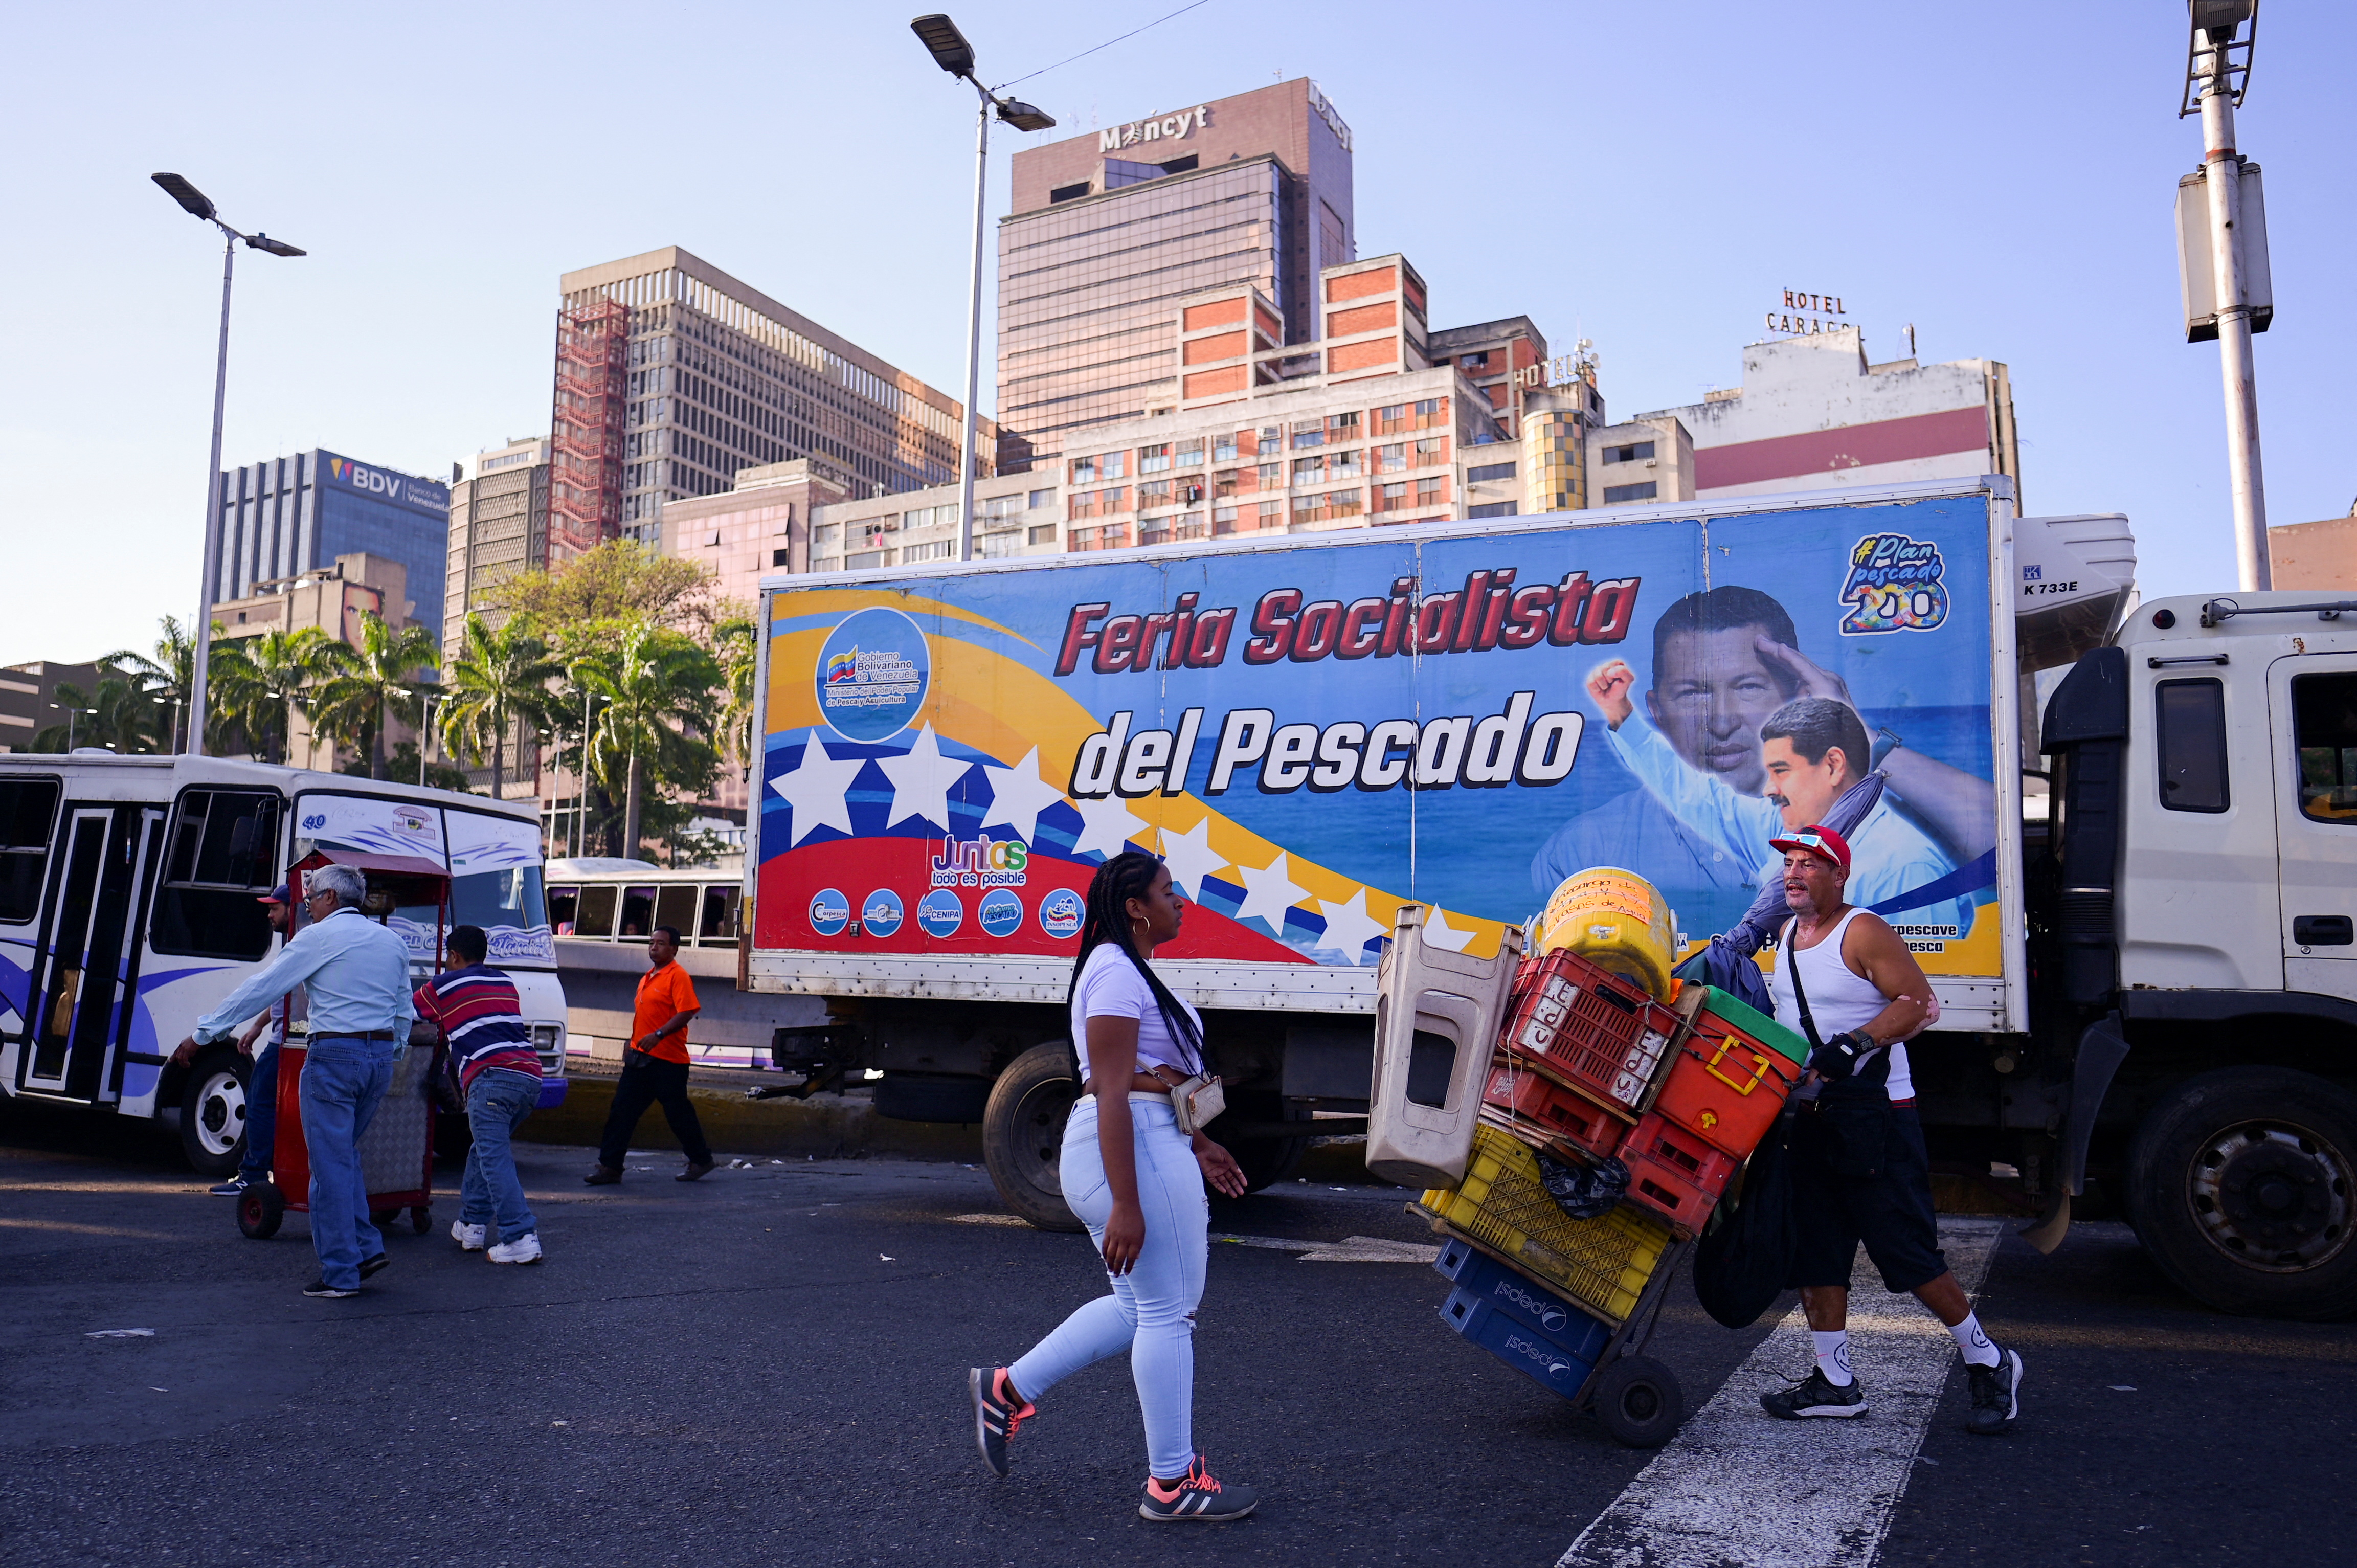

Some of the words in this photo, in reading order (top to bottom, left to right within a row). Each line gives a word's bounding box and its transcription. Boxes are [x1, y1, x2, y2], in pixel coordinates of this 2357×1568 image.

[1784, 290, 1846, 314] HOTEL
[1514, 355, 1577, 390] HOTEL
[353, 466, 400, 498] BDV
[407, 492, 450, 513] Venezuela
[431, 492, 441, 501] de
[1855, 537, 1933, 567] #Plan
[1848, 557, 1941, 591] pescado
[2024, 586, 2035, 595] K
[2039, 581, 2078, 594] 733E
[1053, 592, 1237, 676] Feria
[1243, 568, 1641, 666] Socialista
[858, 652, 899, 662] Gobierno
[858, 660, 912, 671] Bolivariano
[857, 672, 867, 681] de
[870, 669, 917, 680] Venezuela
[893, 686, 918, 694] Popular
[1068, 707, 1204, 799] del
[1204, 690, 1585, 796] Pescado
[302, 814, 327, 830] 40
[934, 836, 1026, 870] Juntos
[933, 872, 956, 884] todo
[962, 875, 976, 884] es
[983, 872, 1025, 887] posible
[813, 903, 845, 921] Corpesca
[984, 910, 1017, 922] PESCADO
[1905, 942, 1943, 952] esca
[1494, 1281, 1546, 1314] pepsi
[1505, 1334, 1553, 1365] pepsi
